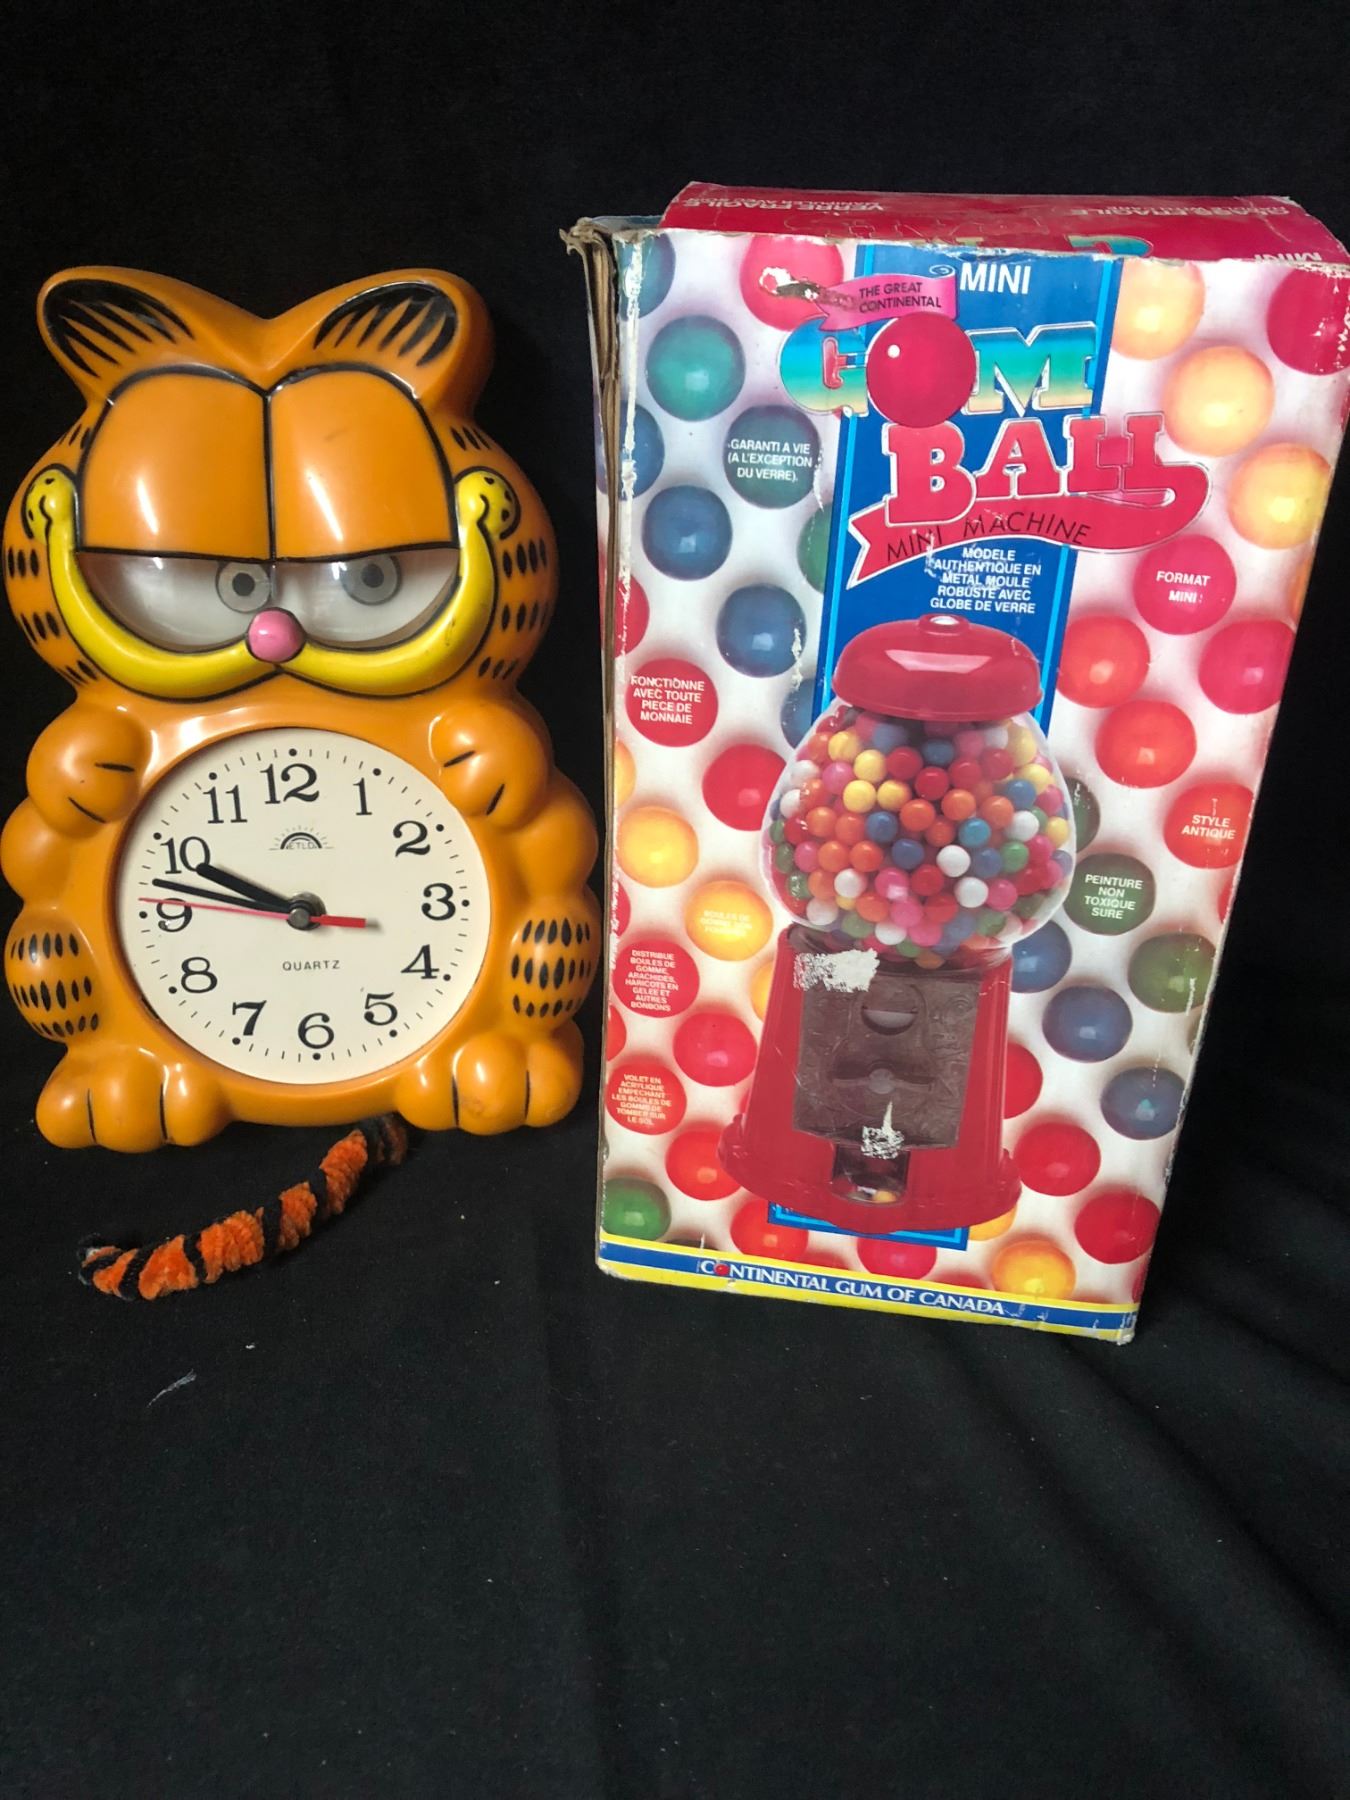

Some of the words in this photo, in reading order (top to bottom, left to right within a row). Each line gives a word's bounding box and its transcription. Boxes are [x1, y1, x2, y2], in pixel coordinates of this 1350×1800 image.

[960, 262, 1032, 295] MINI
[859, 285, 881, 299] THE
[883, 282, 924, 295] GREAT
[859, 295, 942, 313] CONTINENTAL
[730, 438, 780, 452] GARANTI
[782, 442, 791, 453] A
[792, 443, 811, 455] VIE
[727, 452, 739, 464] (A
[741, 453, 813, 468] L'EXCEPTION
[737, 467, 754, 478] DU
[881, 411, 1210, 526] BALL
[887, 524, 943, 562] MINI
[962, 511, 1092, 545] MACHINE
[961, 547, 1017, 561] MODELE
[933, 558, 1022, 575] AUTHENTIQUE
[1023, 564, 1042, 576] EN
[942, 572, 982, 586] METAL
[984, 575, 1031, 588] MOULE
[1155, 570, 1211, 587] FORMAT
[937, 585, 997, 600] ROBUSTE
[998, 589, 1032, 601] AVEC
[1168, 590, 1198, 604] MINI
[930, 598, 973, 611] GLOBE
[974, 600, 993, 612] DE
[994, 602, 1037, 614] VERRE
[630, 675, 706, 691] FONCTIONNE
[633, 688, 663, 700] AVEC
[664, 690, 703, 703] TOUTE
[641, 700, 674, 711] PIECE
[676, 703, 693, 713] DE
[640, 711, 694, 725] MONNAIE
[260, 762, 320, 805] 12
[203, 784, 249, 825] 11
[352, 777, 373, 817] 1
[1191, 814, 1231, 828] STYLE
[392, 820, 431, 857] 2
[1180, 825, 1237, 840] ANTIQUE
[160, 835, 211, 875] 10
[1084, 873, 1145, 890] PEINTURE
[1097, 886, 1126, 898] NON
[421, 882, 456, 921] 3
[1084, 895, 1137, 910] TOXIQUE
[156, 897, 193, 933] 9
[1091, 908, 1124, 920] SURE
[400, 944, 440, 980] 4
[630, 957, 663, 966] BOULES
[664, 960, 676, 968] DE
[631, 949, 675, 960] DISTRIBUE
[282, 959, 341, 972] QUARTZ
[180, 956, 218, 994] 8
[625, 979, 666, 989] HARICOTS
[667, 983, 679, 991] EN
[631, 1001, 671, 1012] BONBONS
[635, 994, 667, 1004] AUTRES
[363, 991, 399, 1027] 5
[231, 999, 268, 1037] 7
[297, 1012, 335, 1050] 6
[700, 1259, 831, 1293] CONTINENTAL
[835, 1279, 883, 1300] GUM
[886, 1287, 916, 1303] OF
[918, 1291, 1006, 1316] CANADA
